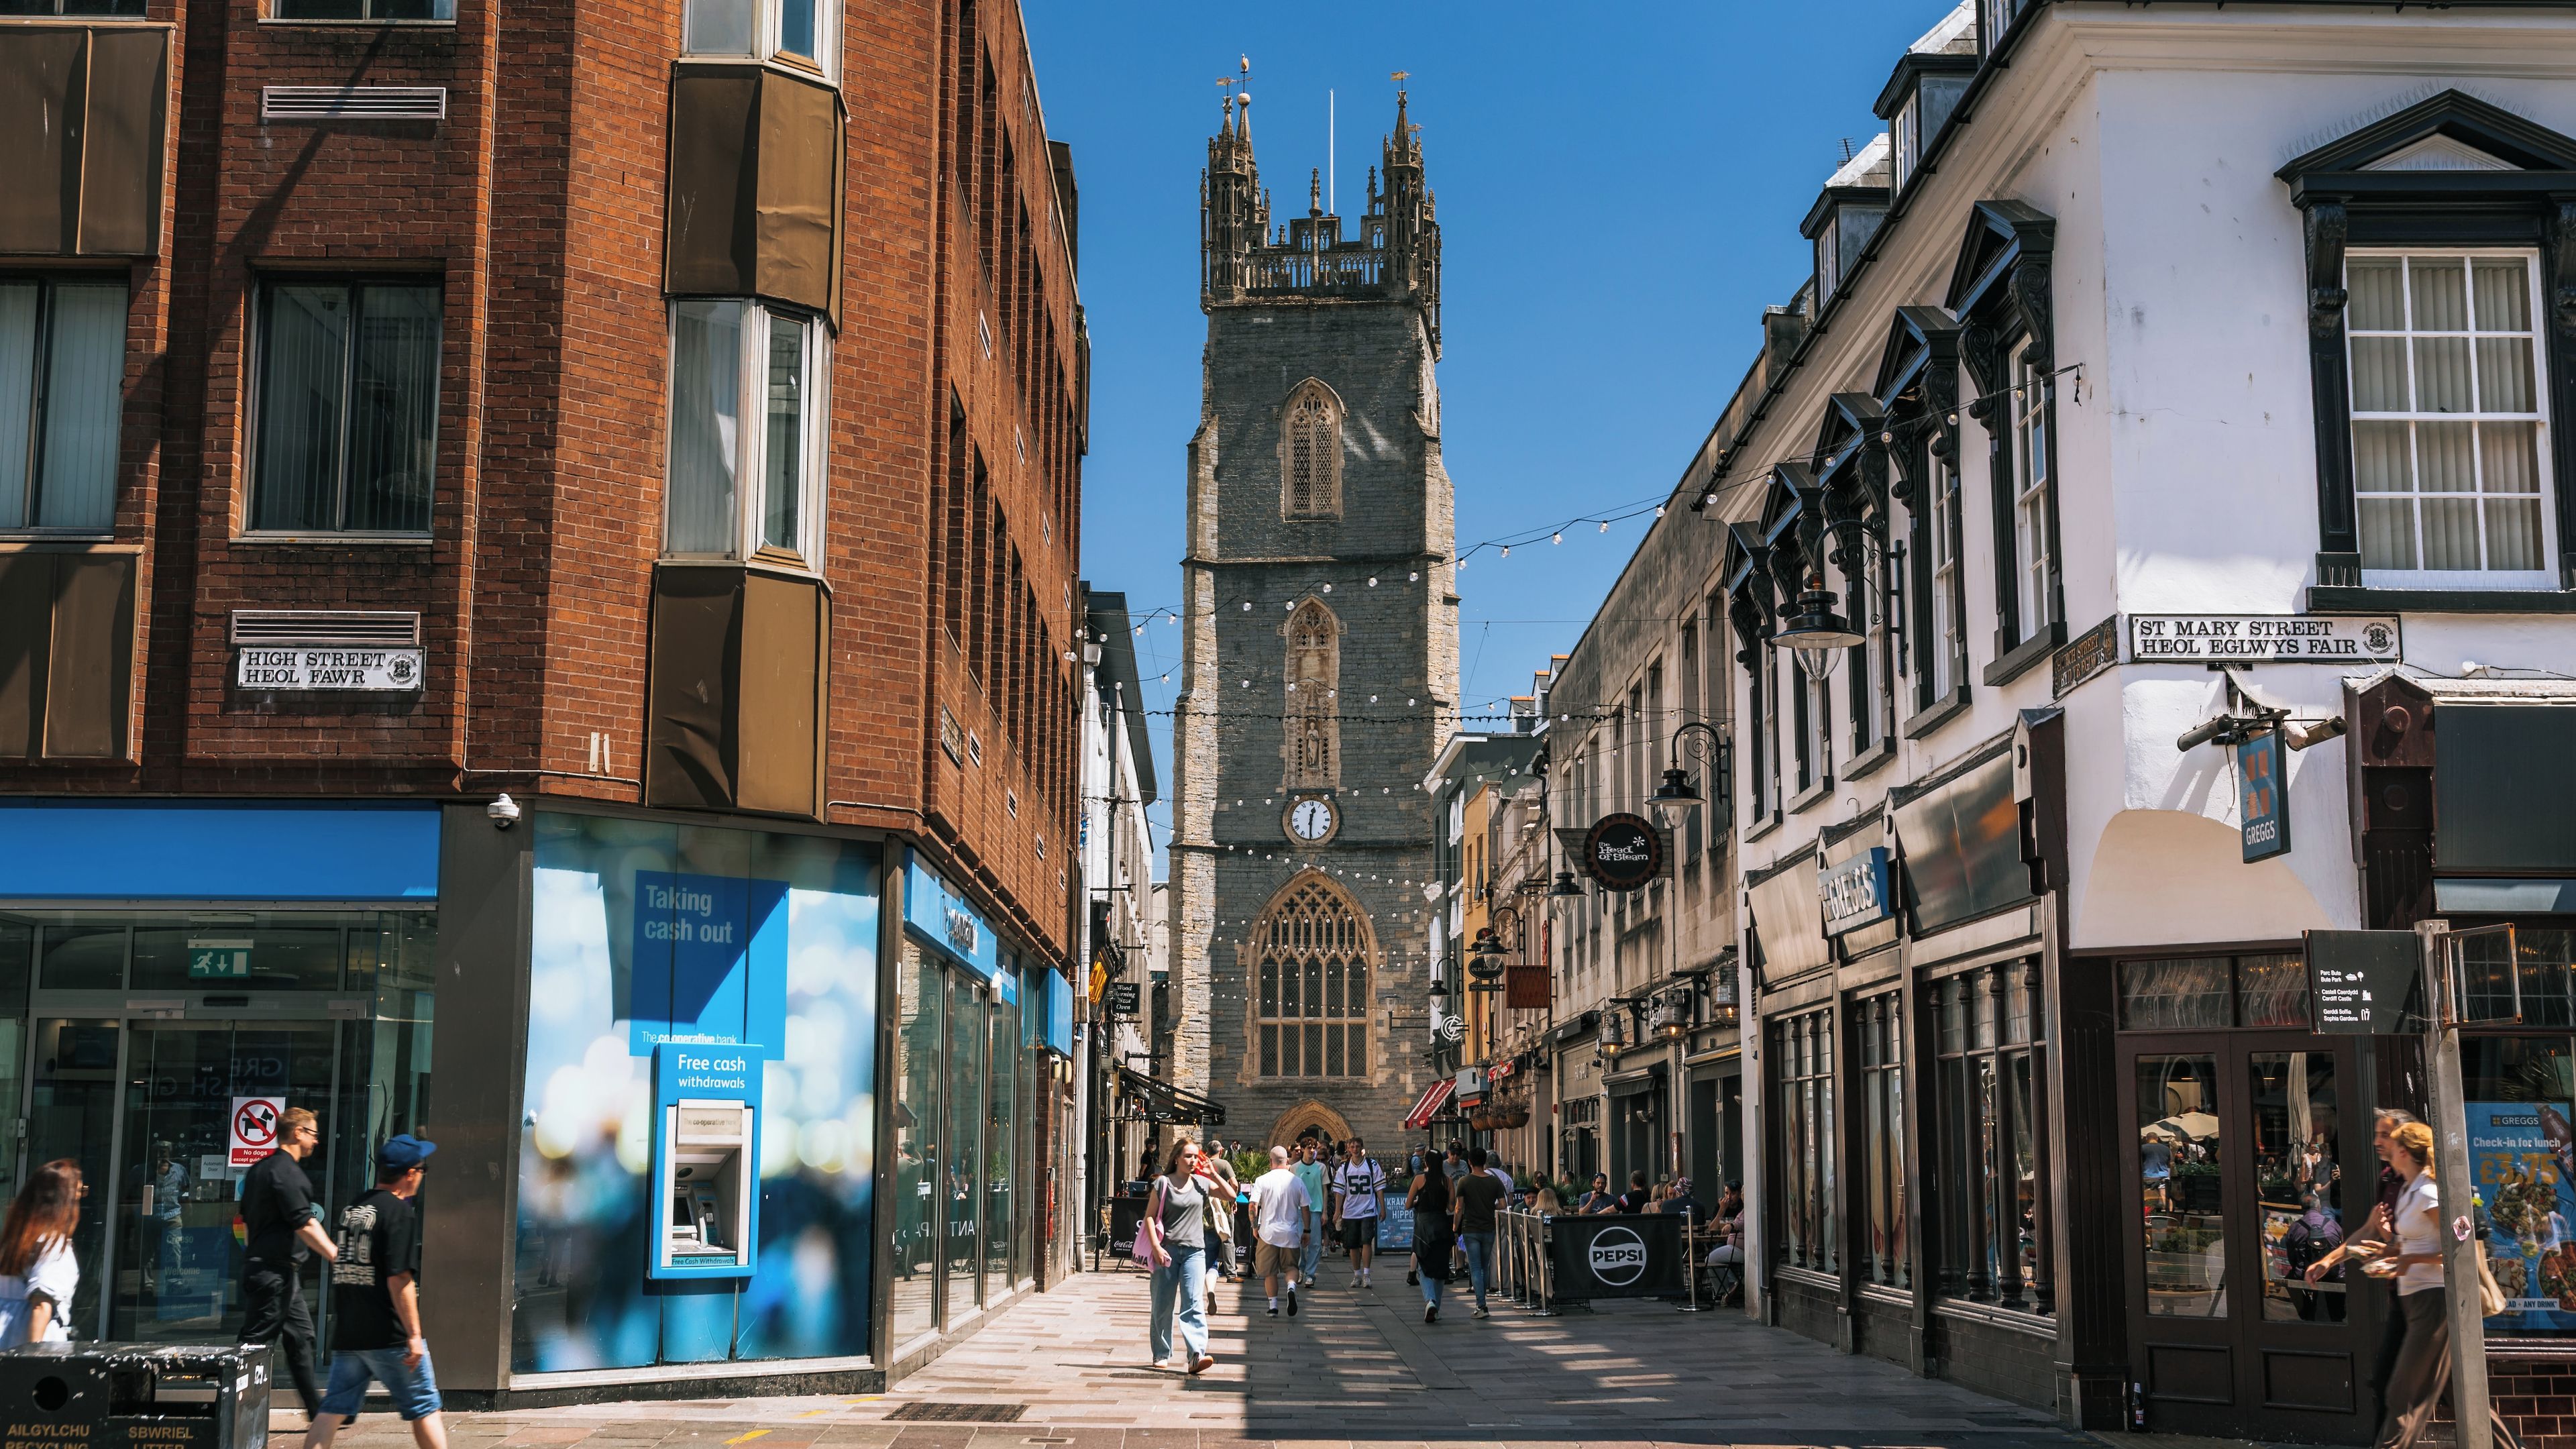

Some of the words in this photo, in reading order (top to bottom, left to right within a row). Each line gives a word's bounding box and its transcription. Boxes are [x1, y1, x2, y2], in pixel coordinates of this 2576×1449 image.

[2141, 621, 2165, 635] ST
[2176, 621, 2240, 636] MARY
[2250, 621, 2333, 635] STREET
[2077, 633, 2099, 658] STREET
[2143, 639, 2200, 653] HEOL
[2210, 639, 2300, 653] EGLWYS
[2307, 639, 2357, 653] FAIR
[246, 652, 298, 666] HIGH
[306, 652, 386, 667] STREET
[245, 669, 300, 683] HEOL
[309, 669, 366, 684] FAWR
[2246, 820, 2275, 846] GREGGS
[1599, 846, 1634, 854] Head
[1613, 853, 1649, 861] Steam
[1826, 863, 1876, 920] GREGGS
[645, 885, 712, 917] Taking
[644, 918, 692, 941] cash
[700, 921, 733, 944] out
[641, 1031, 657, 1043] The
[657, 1033, 715, 1044] cooperative
[716, 1034, 737, 1044] bank
[678, 1054, 710, 1070] Free
[713, 1056, 746, 1071] cash
[678, 1075, 745, 1089] withdrawals
[692, 1118, 725, 1127] co-operative
[2502, 1117, 2539, 1125] GREGGS
[2473, 1137, 2516, 1147] Check-in
[2518, 1137, 2532, 1147] for
[2534, 1137, 2561, 1148] lunch
[2479, 1153, 2559, 1185] £3.75
[1347, 1175, 1371, 1195] 52
[1387, 1197, 1408, 1205] KRAK
[1392, 1210, 1414, 1219] HIPPO
[700, 1256, 735, 1265] Withdrawals
[1593, 1249, 1643, 1263] PEPSI
[164, 1266, 201, 1275] Welcome
[7, 1424, 91, 1437] AILGYLCHU
[127, 1426, 194, 1439] SBWRIEL
